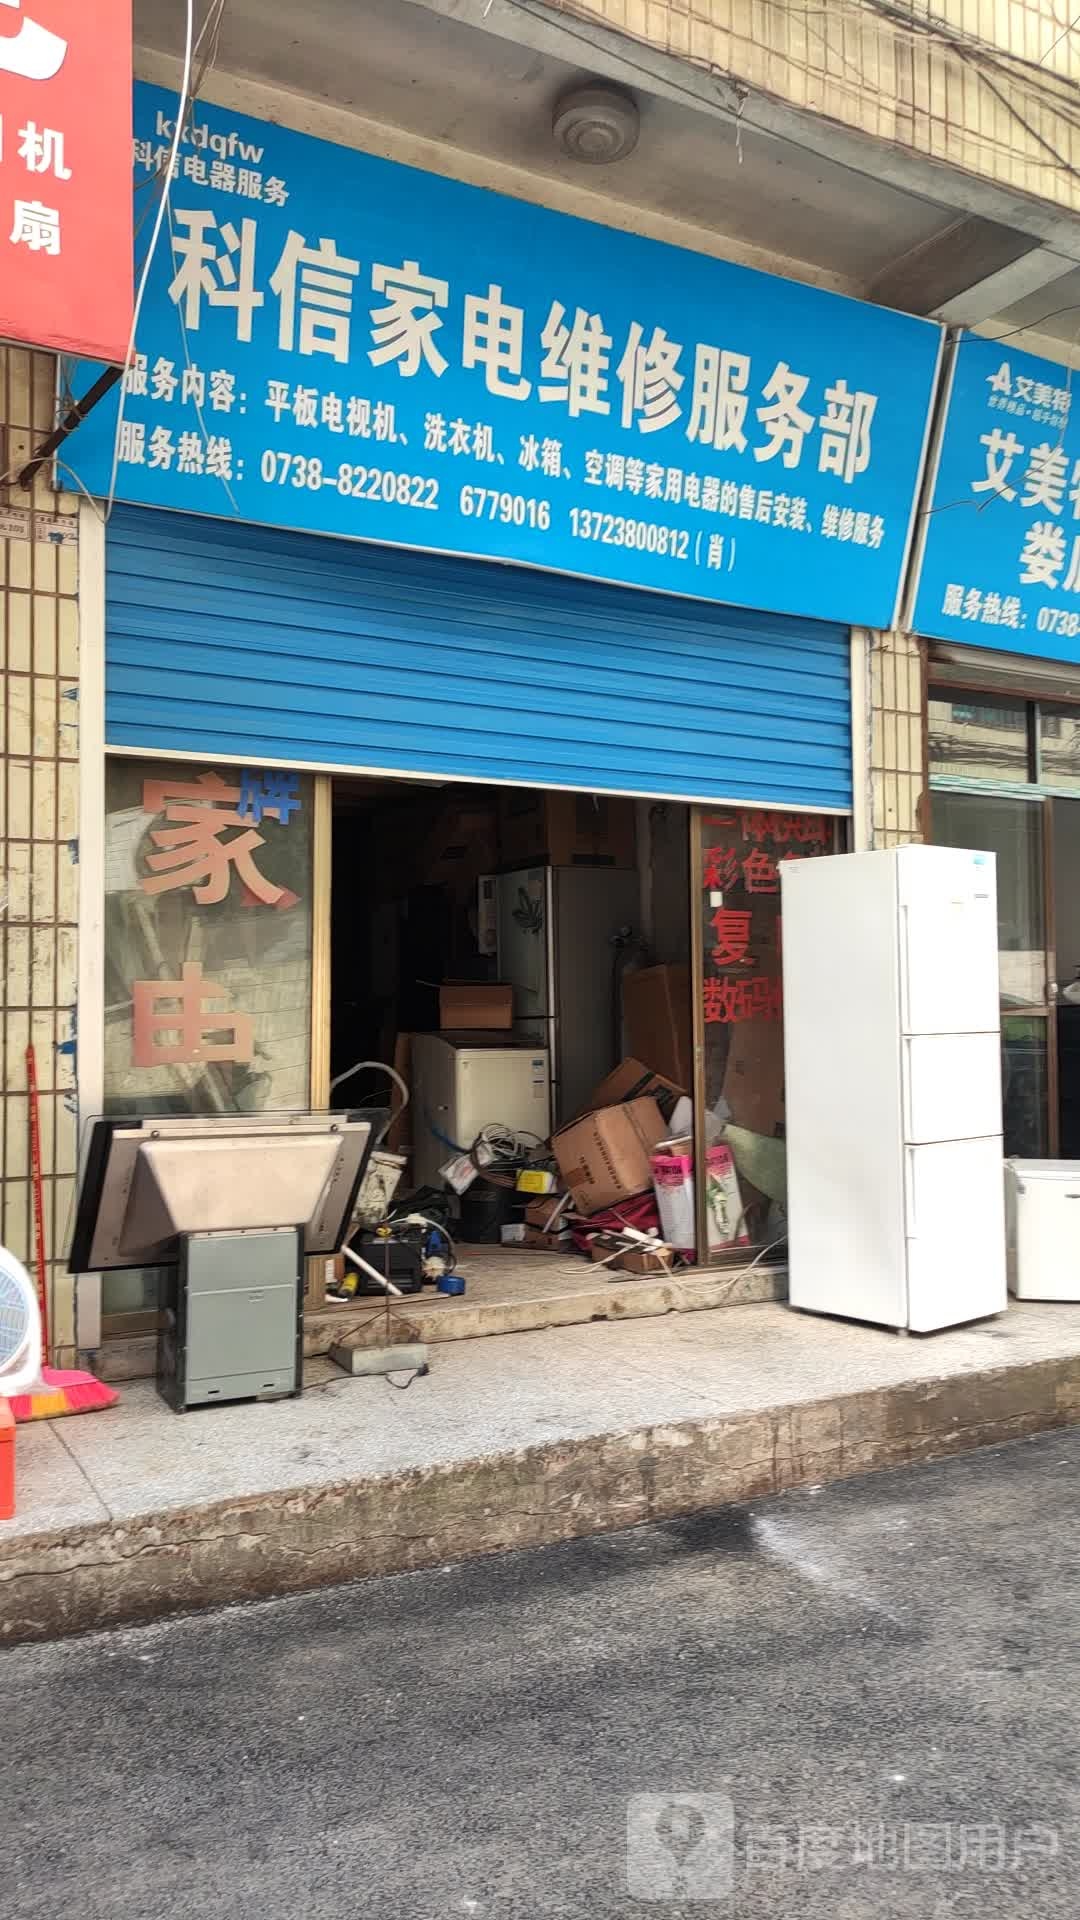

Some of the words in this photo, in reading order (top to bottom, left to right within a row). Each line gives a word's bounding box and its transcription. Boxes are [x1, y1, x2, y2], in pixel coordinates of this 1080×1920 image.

[17, 120, 73, 181] 机
[156, 110, 265, 164] kxdqfw
[132, 138, 290, 207] 科信电器服务
[9, 199, 61, 256] 扇
[168, 208, 878, 484] 科信家电维修服务部
[460, 485, 550, 530] 6779016
[703, 976, 783, 1024] 数码
